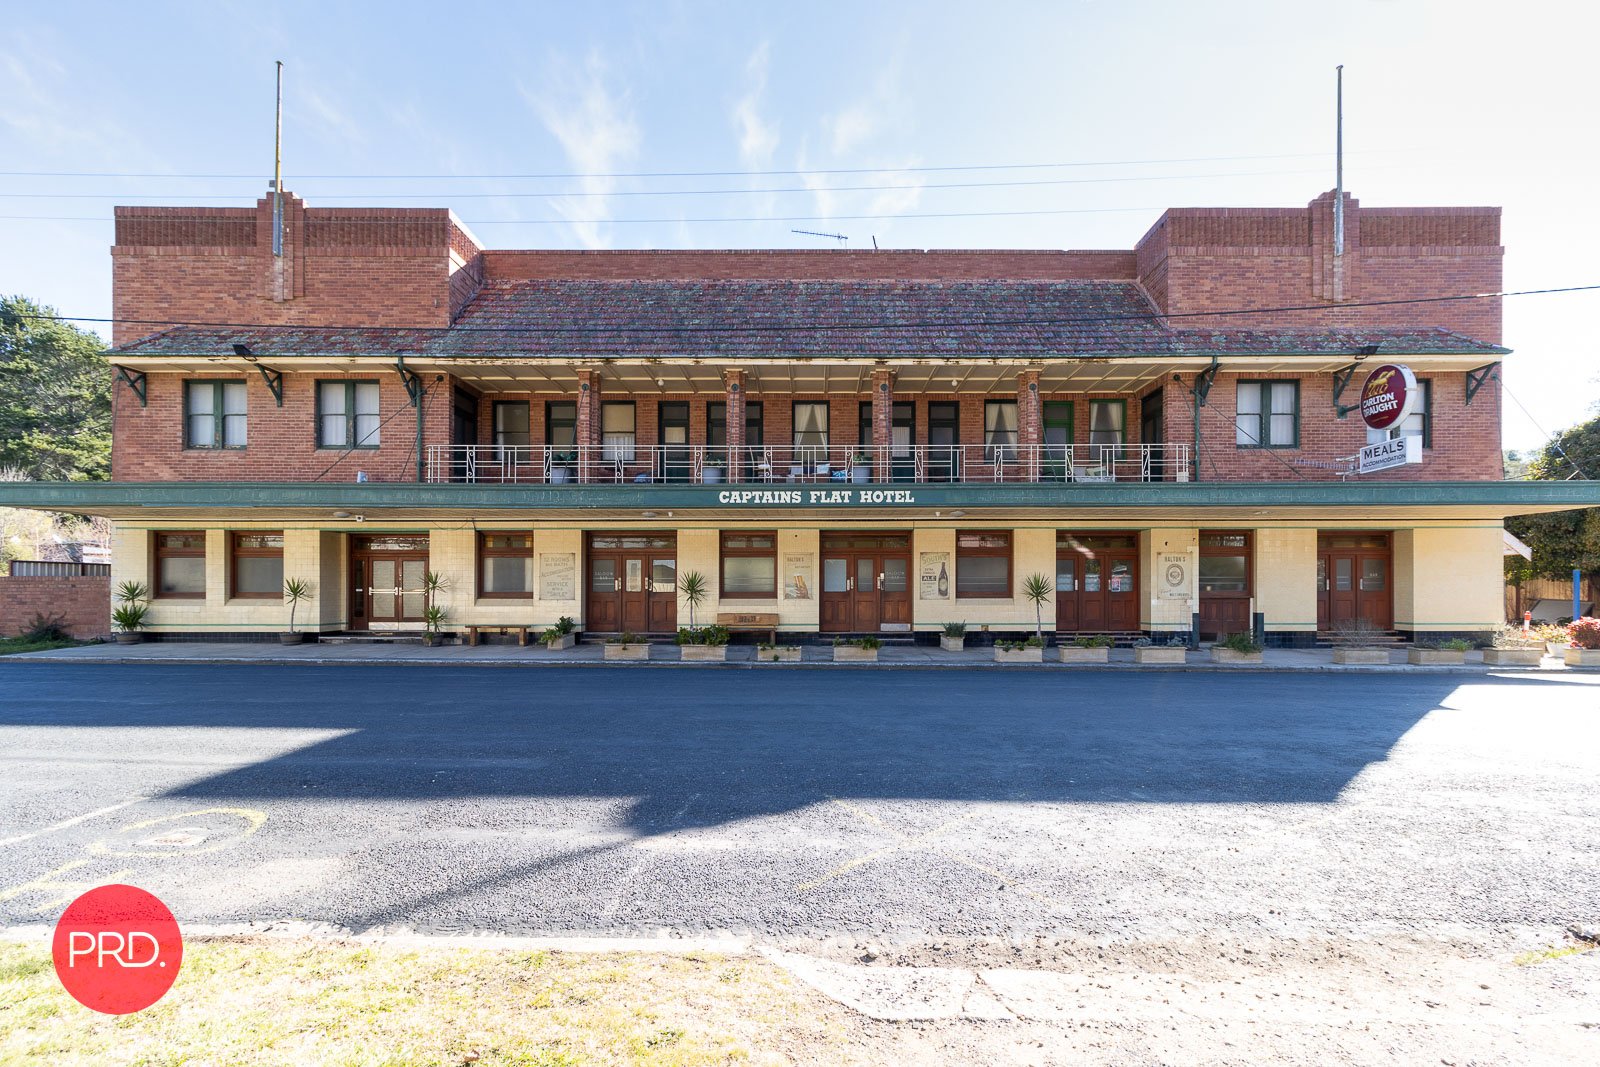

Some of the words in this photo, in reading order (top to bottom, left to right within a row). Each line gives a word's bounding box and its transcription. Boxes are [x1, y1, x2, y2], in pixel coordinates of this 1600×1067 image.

[1363, 392, 1395, 408] CARLTON
[1363, 400, 1398, 417] DRAUGHT
[1364, 441, 1404, 460] MEALS
[1362, 454, 1406, 468] ACCOMMODATION
[719, 491, 802, 504] CAPTAINS
[810, 491, 852, 503] FLAT
[859, 490, 915, 503] HOTEL
